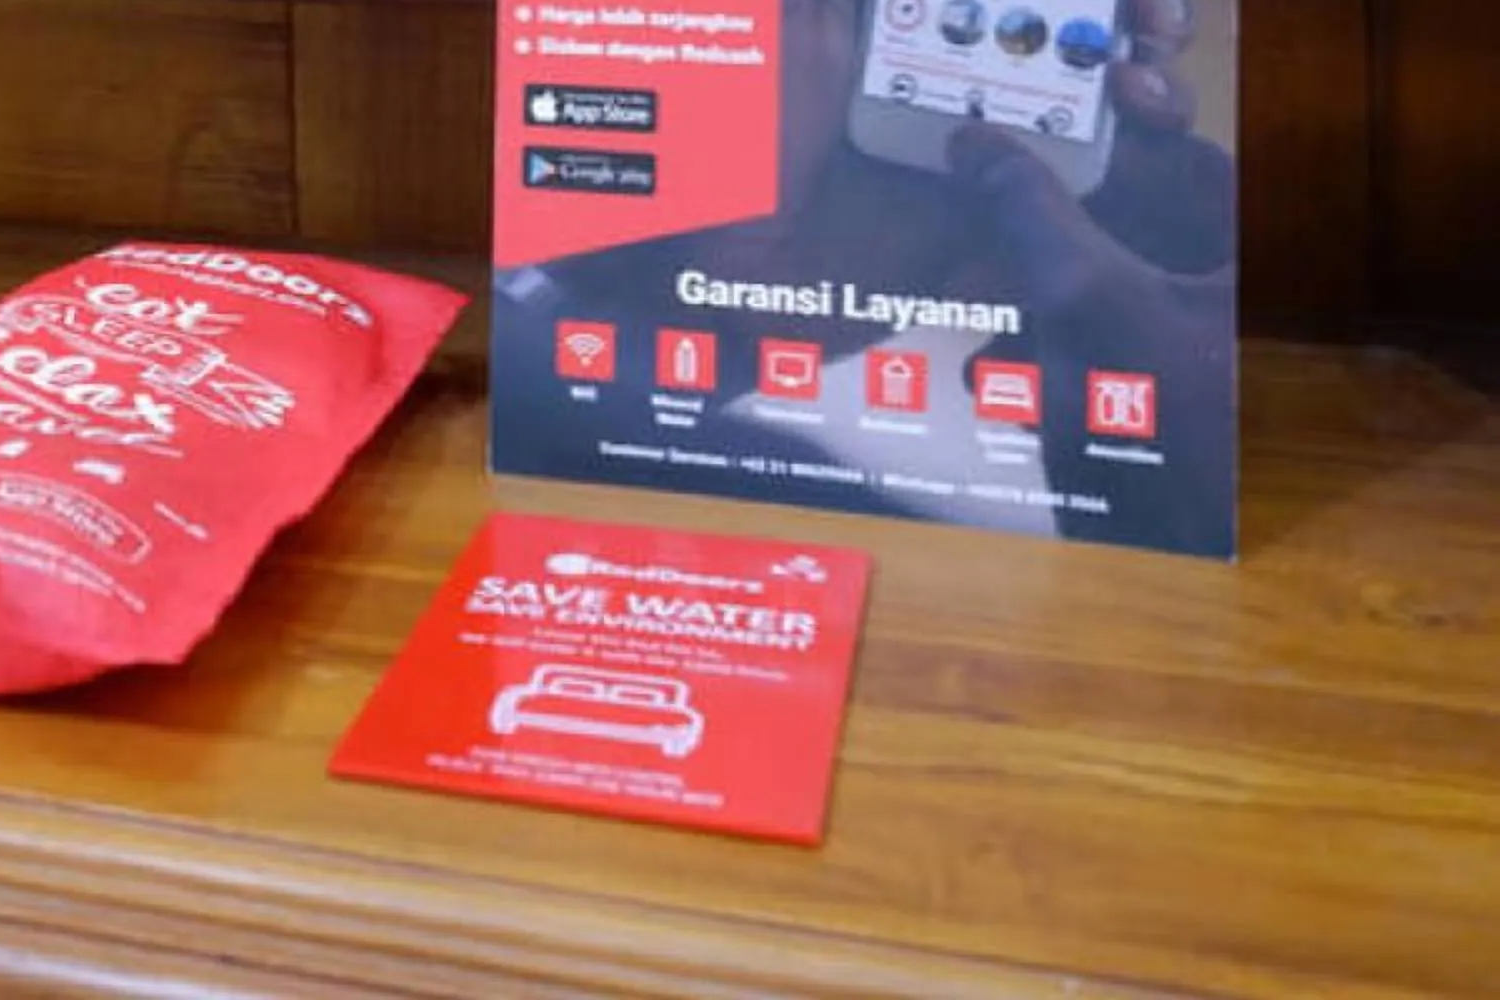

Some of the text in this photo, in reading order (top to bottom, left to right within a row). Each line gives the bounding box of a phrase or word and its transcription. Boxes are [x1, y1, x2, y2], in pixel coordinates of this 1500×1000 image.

[675, 268, 1022, 335] Garansi Layanan
[475, 575, 817, 640] SAVE WATER
